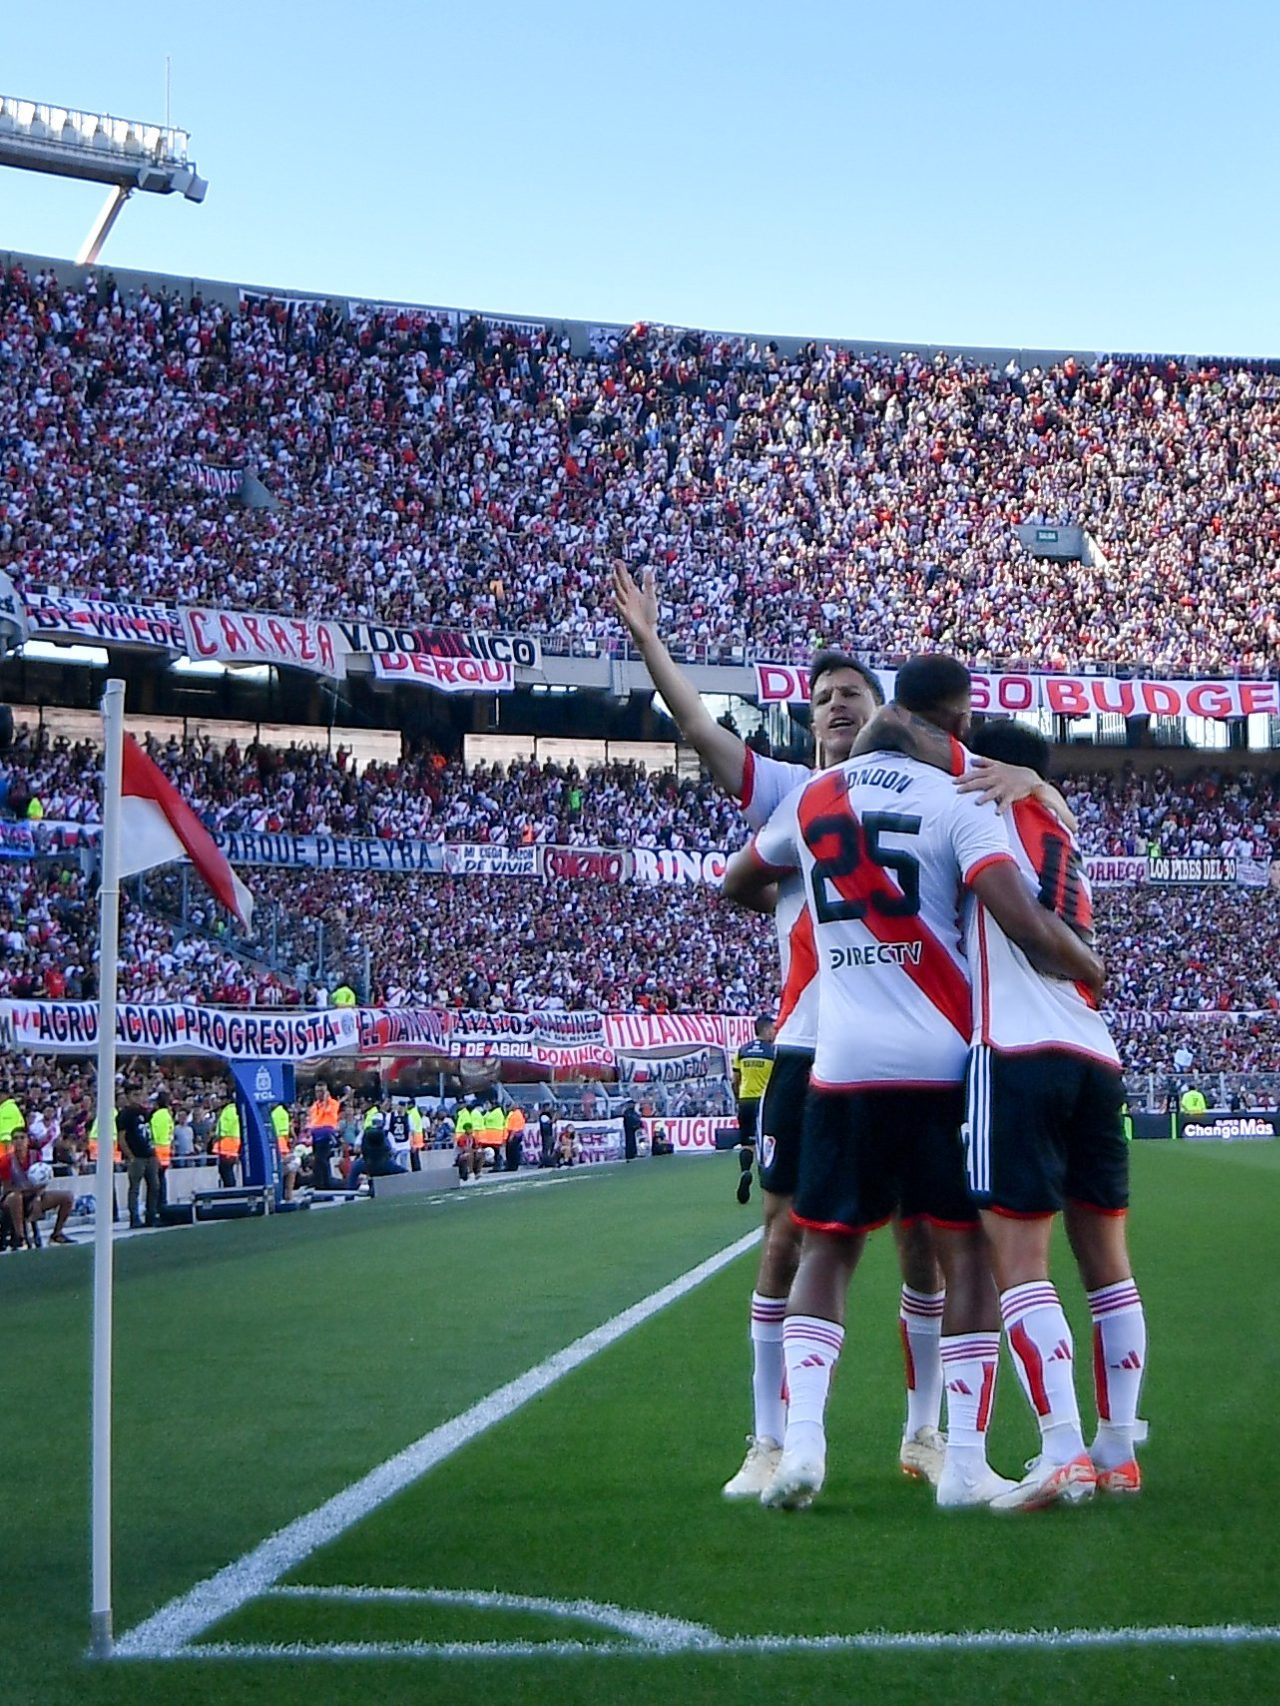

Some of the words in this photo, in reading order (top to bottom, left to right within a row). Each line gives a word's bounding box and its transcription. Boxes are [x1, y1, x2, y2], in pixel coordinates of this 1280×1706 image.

[23, 590, 73, 614] LAS
[80, 599, 180, 626] TORRES
[33, 609, 84, 632] DE
[89, 613, 187, 648] WILDE
[379, 652, 511, 685] DERQUI
[1045, 678, 1279, 718] BUDGE
[836, 766, 914, 795] ONDON
[214, 831, 308, 865] PARQUE
[316, 837, 434, 869] PEREYRA
[490, 860, 534, 873] VIVIR
[633, 848, 737, 885] RINC
[805, 810, 922, 925] 25
[1149, 858, 1169, 877] LOS
[1170, 859, 1202, 880] PIBES
[829, 941, 922, 970] DIRECTV
[38, 1002, 178, 1045] AGRUACION
[182, 1005, 338, 1056] PROGRESISTA
[605, 1015, 726, 1049] ITUZAINGO
[464, 1042, 485, 1058] DE
[488, 1041, 532, 1058] ABRIL
[536, 1045, 614, 1067] DOMINICO
[253, 1091, 276, 1102] TCL
